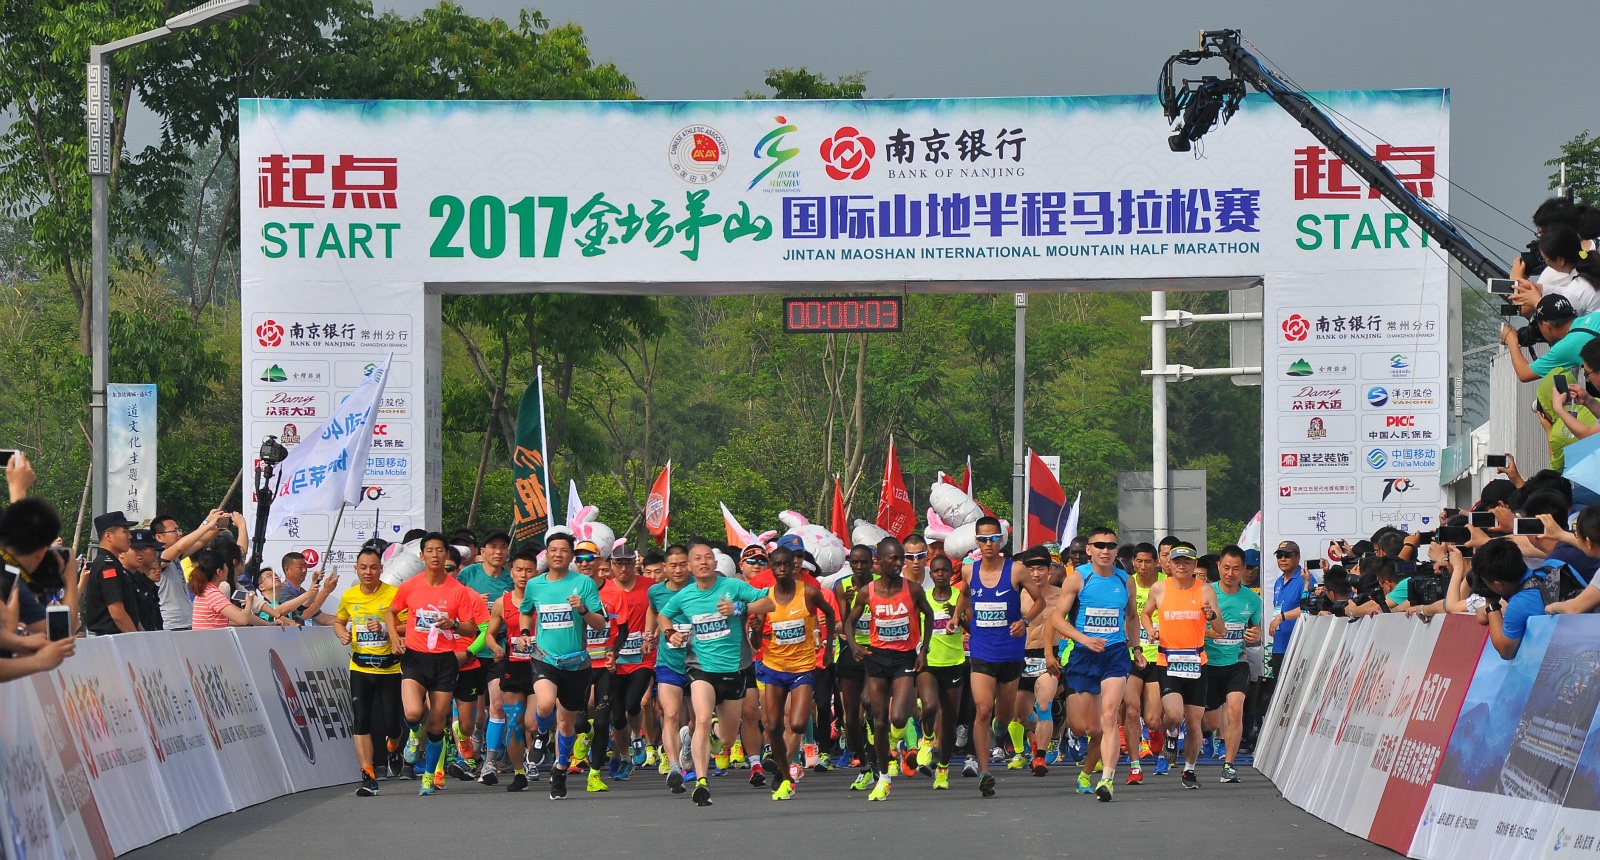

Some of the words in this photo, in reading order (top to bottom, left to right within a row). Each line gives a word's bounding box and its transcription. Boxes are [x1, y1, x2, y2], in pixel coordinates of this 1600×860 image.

[886, 127, 1027, 164] 南京银行
[888, 168, 923, 180] BANK
[935, 167, 955, 179] OF
[959, 166, 1026, 179] NANJING
[1294, 144, 1436, 200] 起点
[258, 154, 398, 209] 起点
[429, 195, 568, 258] 2017
[782, 188, 1261, 240] 国际山地半程马拉松赛
[260, 222, 401, 259] START
[783, 249, 835, 261] JINTAN
[840, 247, 916, 261] MAOSHAN
[920, 245, 1041, 260] INTERNATIONAL
[1046, 244, 1125, 257] MOUNTAIN
[1130, 243, 1169, 256] HALF
[1173, 241, 1261, 255] MARATHON
[789, 300, 897, 329] 00:00:03
[1316, 315, 1382, 333] 南京银行
[1387, 320, 1436, 331] 常州分行
[290, 322, 356, 340] 南京银行
[361, 330, 409, 340] 常州分行
[1391, 388, 1433, 399] 洋河股份
[1292, 400, 1342, 410] 众泰大迈
[1386, 416, 1415, 427] PICC
[1369, 431, 1433, 440] 中国人民保险
[1299, 453, 1350, 463] 星艺装饰
[1391, 449, 1436, 460] 中国移动
[1413, 460, 1436, 468] Mobile
[875, 602, 909, 617] FILA
[542, 612, 571, 622] A0574
[977, 611, 1006, 621] A0223
[1086, 617, 1118, 627] A0040
[696, 620, 728, 634] A0494
[878, 627, 909, 637] A0643
[1168, 662, 1200, 672] A0685
